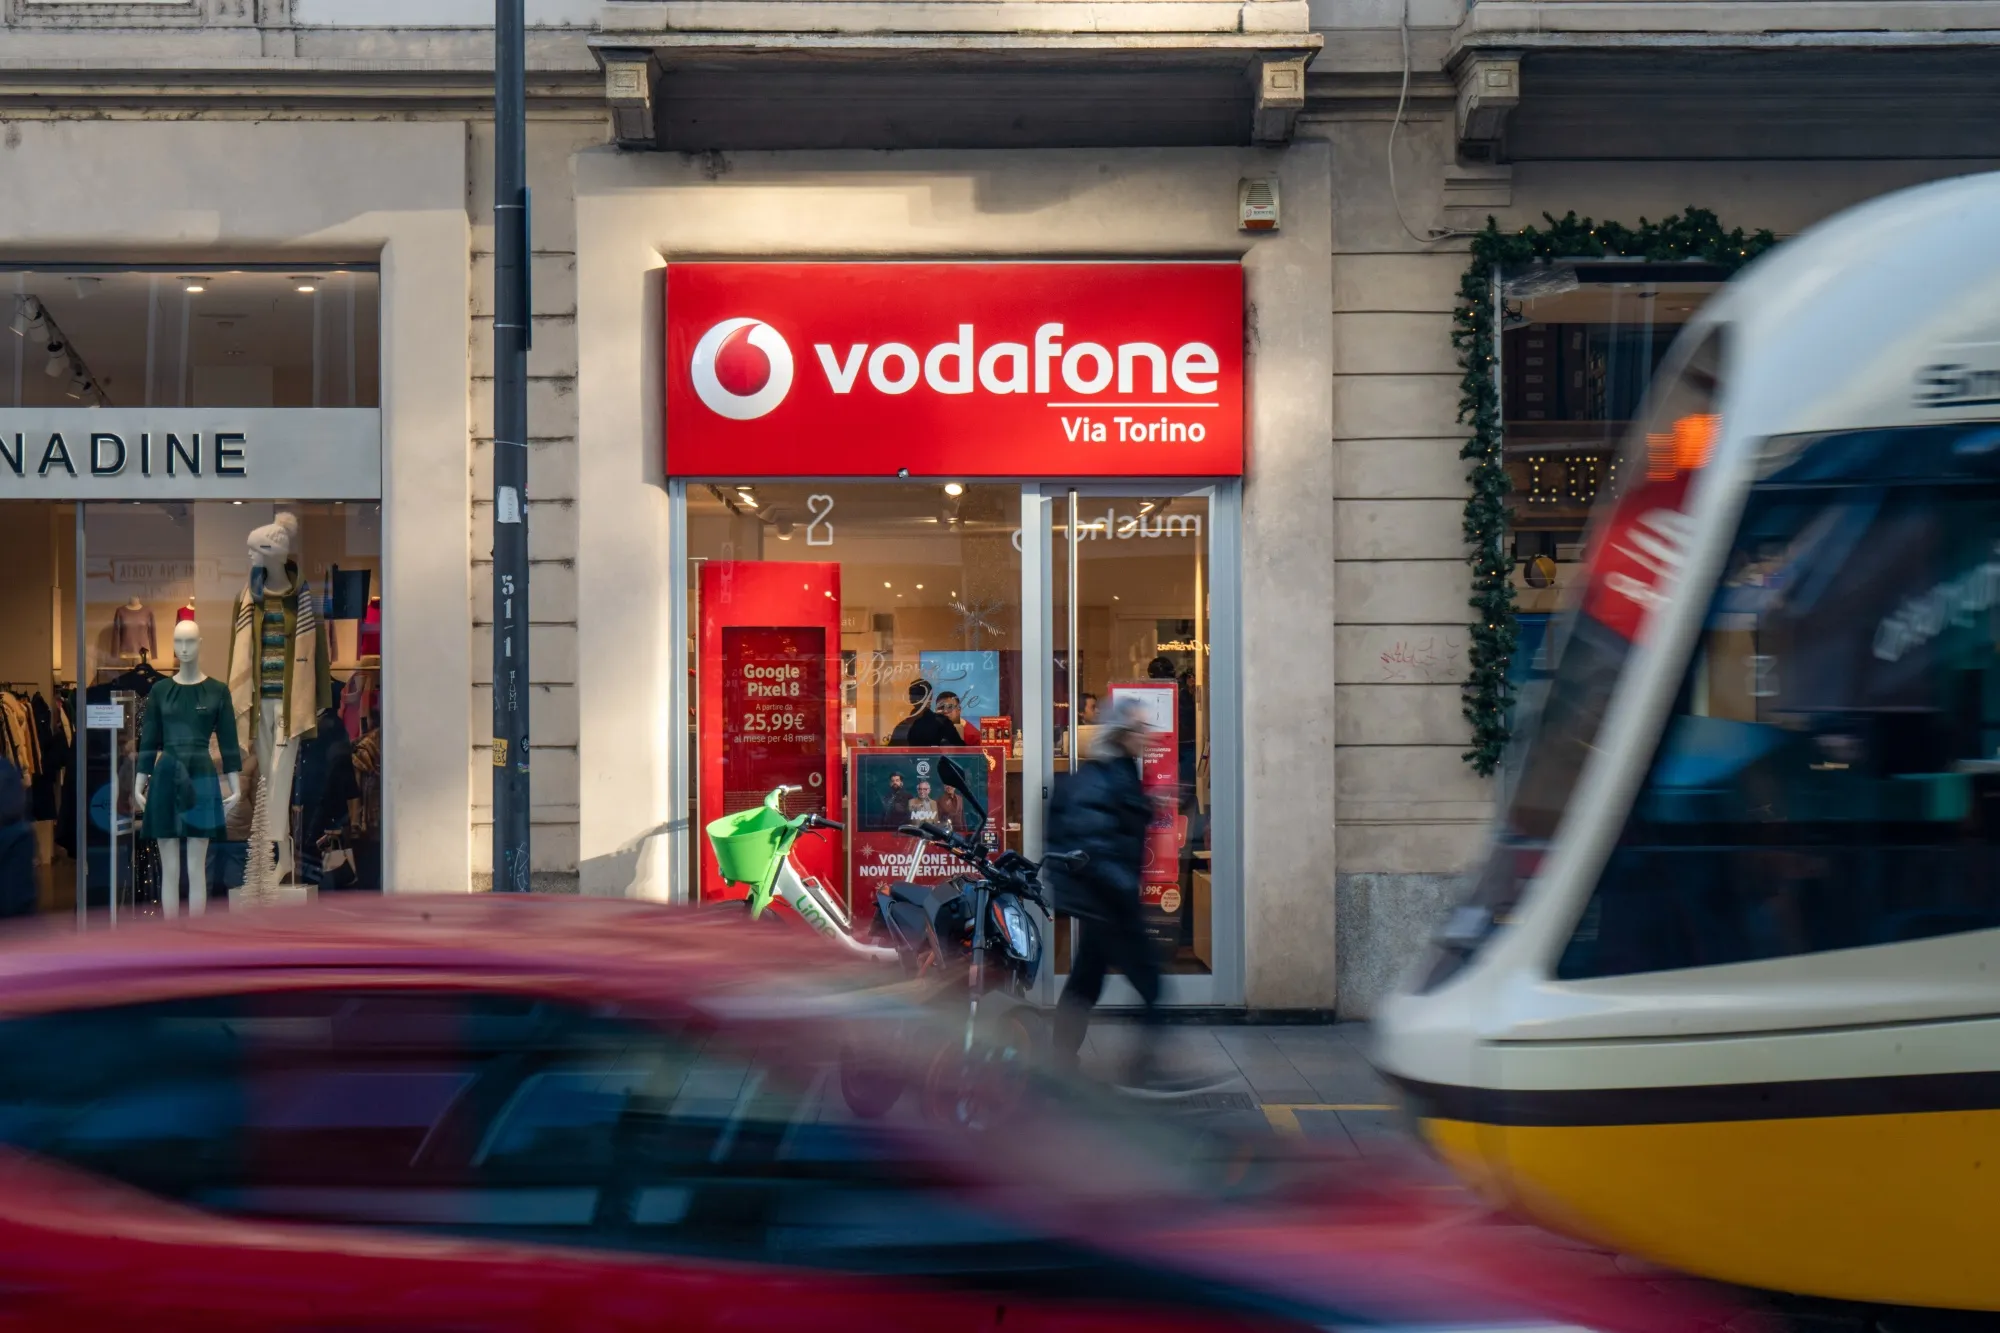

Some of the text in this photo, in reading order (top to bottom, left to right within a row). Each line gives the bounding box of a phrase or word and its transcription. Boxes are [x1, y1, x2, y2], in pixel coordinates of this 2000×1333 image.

[814, 323, 1220, 396] vodafone
[1061, 416, 1206, 442] Via Torino
[0, 433, 247, 476] NADINE
[743, 663, 800, 682] Google
[747, 682, 800, 697] Pixel 8
[755, 703, 793, 713] A partire da
[743, 713, 805, 732] 25,99€
[743, 735, 766, 743] mese
[767, 735, 780, 744] per
[783, 734, 794, 743] 48
[795, 734, 815, 742] mesi
[910, 811, 937, 820] NOW
[879, 854, 947, 865] VODAONE
[860, 866, 889, 876] NOW
